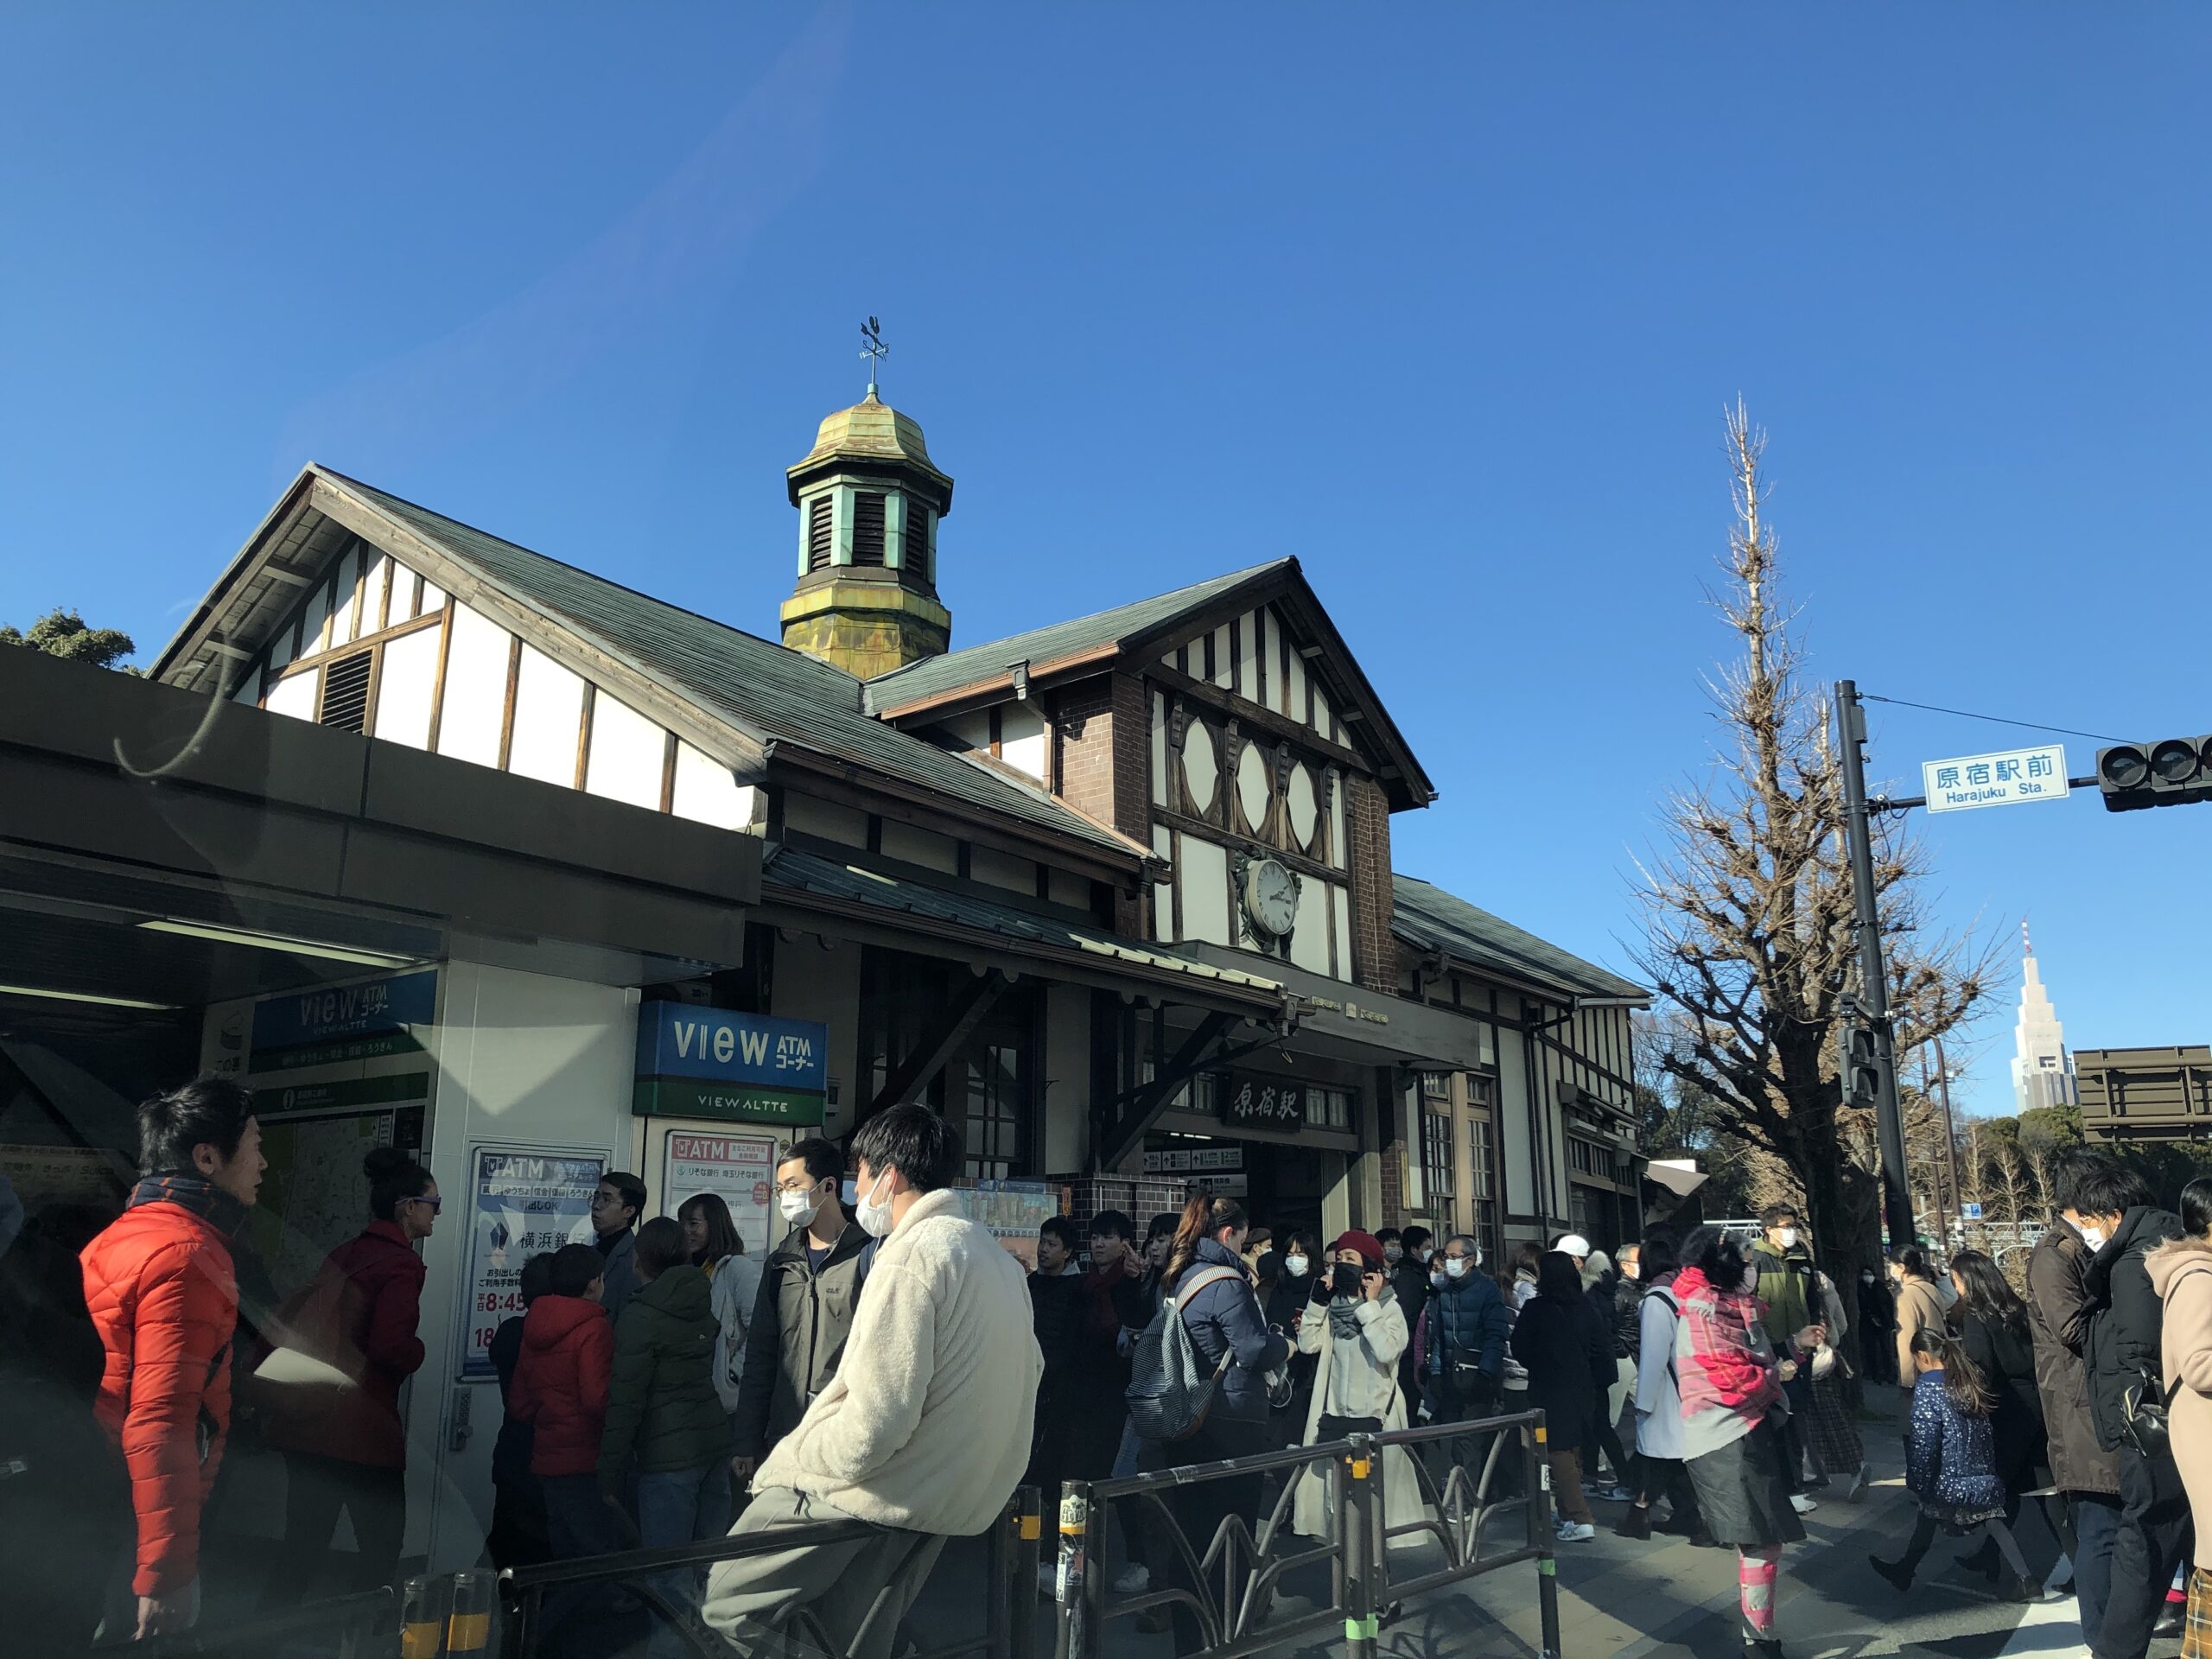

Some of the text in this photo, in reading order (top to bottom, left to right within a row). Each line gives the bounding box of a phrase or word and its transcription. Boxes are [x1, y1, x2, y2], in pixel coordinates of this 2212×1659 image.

[1936, 754, 2053, 790] 原宿駅前
[1946, 783, 2048, 804] Harajuku Sta.
[362, 985, 387, 1002] ATM
[360, 1003, 389, 1018] コーナー
[777, 1035, 812, 1058] ATM
[776, 1054, 815, 1071] コーナー
[1235, 1083, 1299, 1121] 原宿駅
[690, 1140, 724, 1160] ATM
[501, 1157, 544, 1179] ATM
[504, 1186, 530, 1196] ゆうちょ
[486, 1268, 522, 1279] お引出しの
[477, 1293, 486, 1312] 平日
[486, 1292, 527, 1312] 8:45
